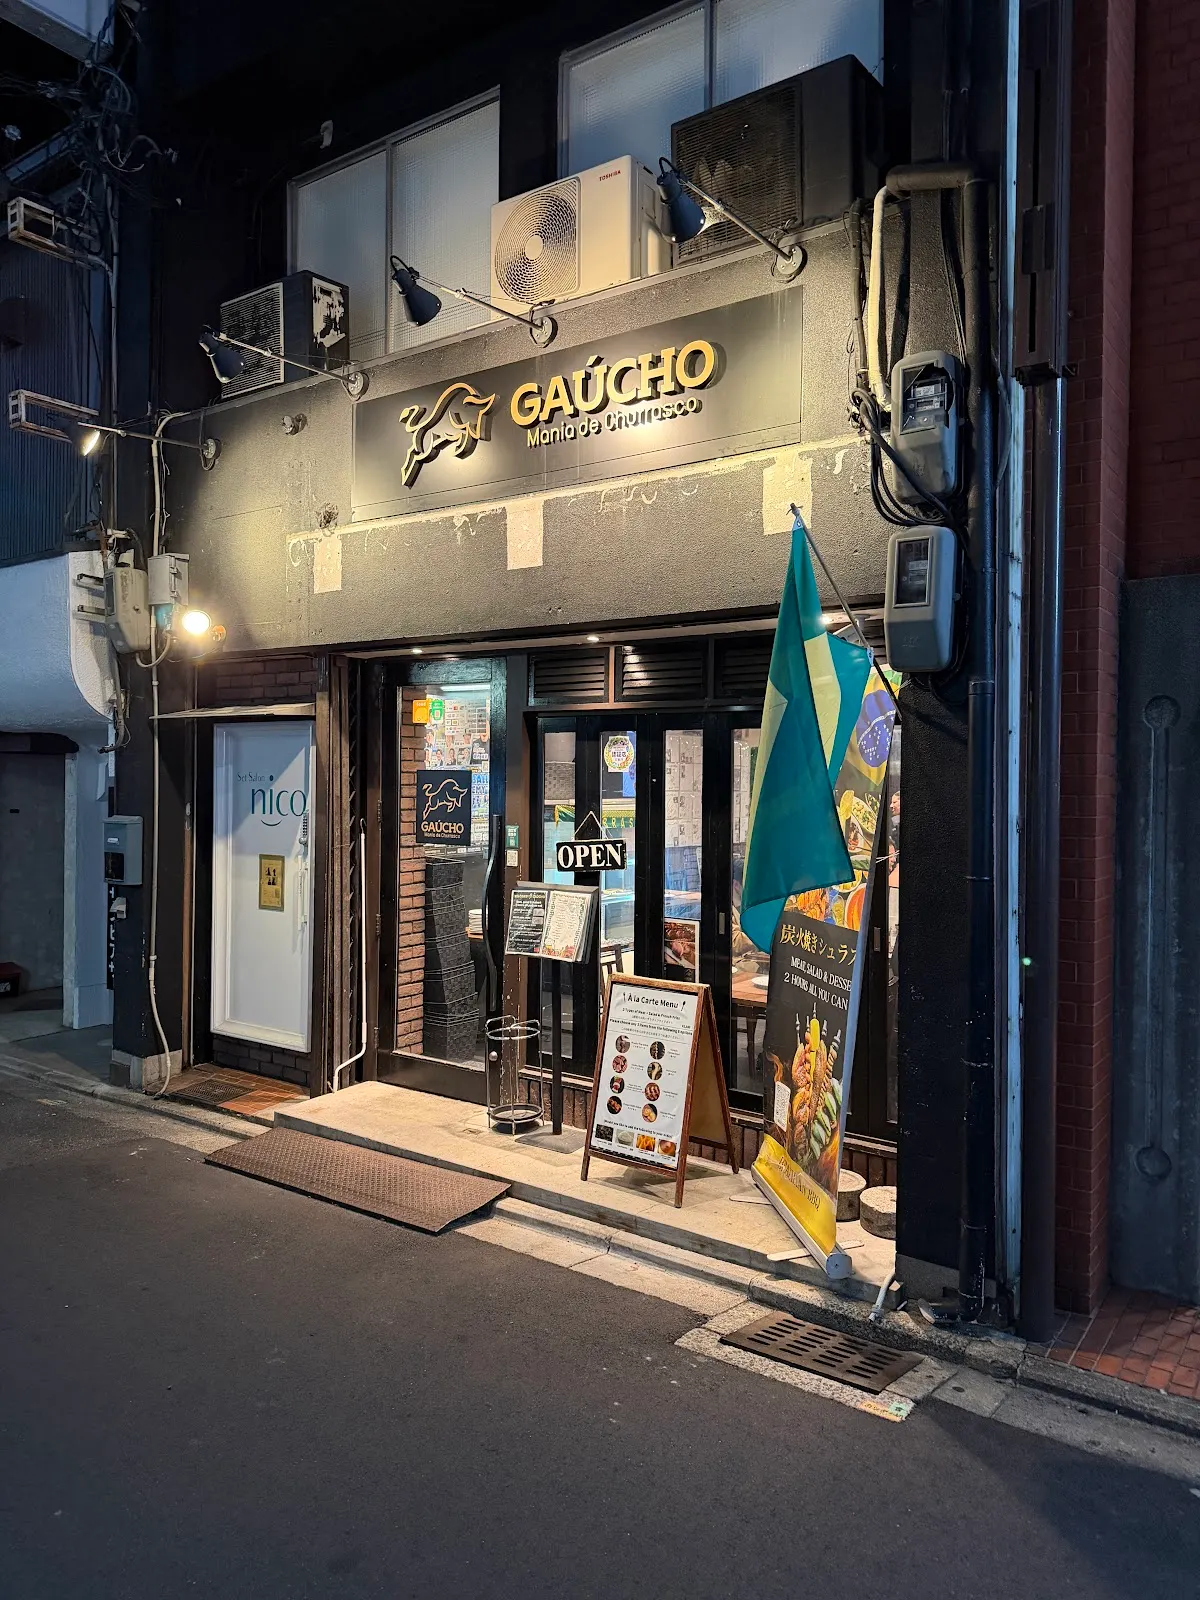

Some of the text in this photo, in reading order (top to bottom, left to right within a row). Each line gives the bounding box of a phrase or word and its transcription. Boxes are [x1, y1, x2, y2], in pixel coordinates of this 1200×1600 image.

[510, 339, 716, 427] GAÚCHO
[527, 396, 699, 447] Mania de Churrasco
[251, 775, 307, 817] nico
[421, 820, 465, 834] GAÚCHO
[557, 844, 622, 869] OPEN
[806, 962, 823, 980] SALAD
[823, 971, 829, 983] &
[633, 994, 640, 1003] la
[641, 996, 659, 1006] Carte
[660, 999, 679, 1009] Menu
[784, 971, 849, 1010] 2 HOURS ALL YOU CAN
